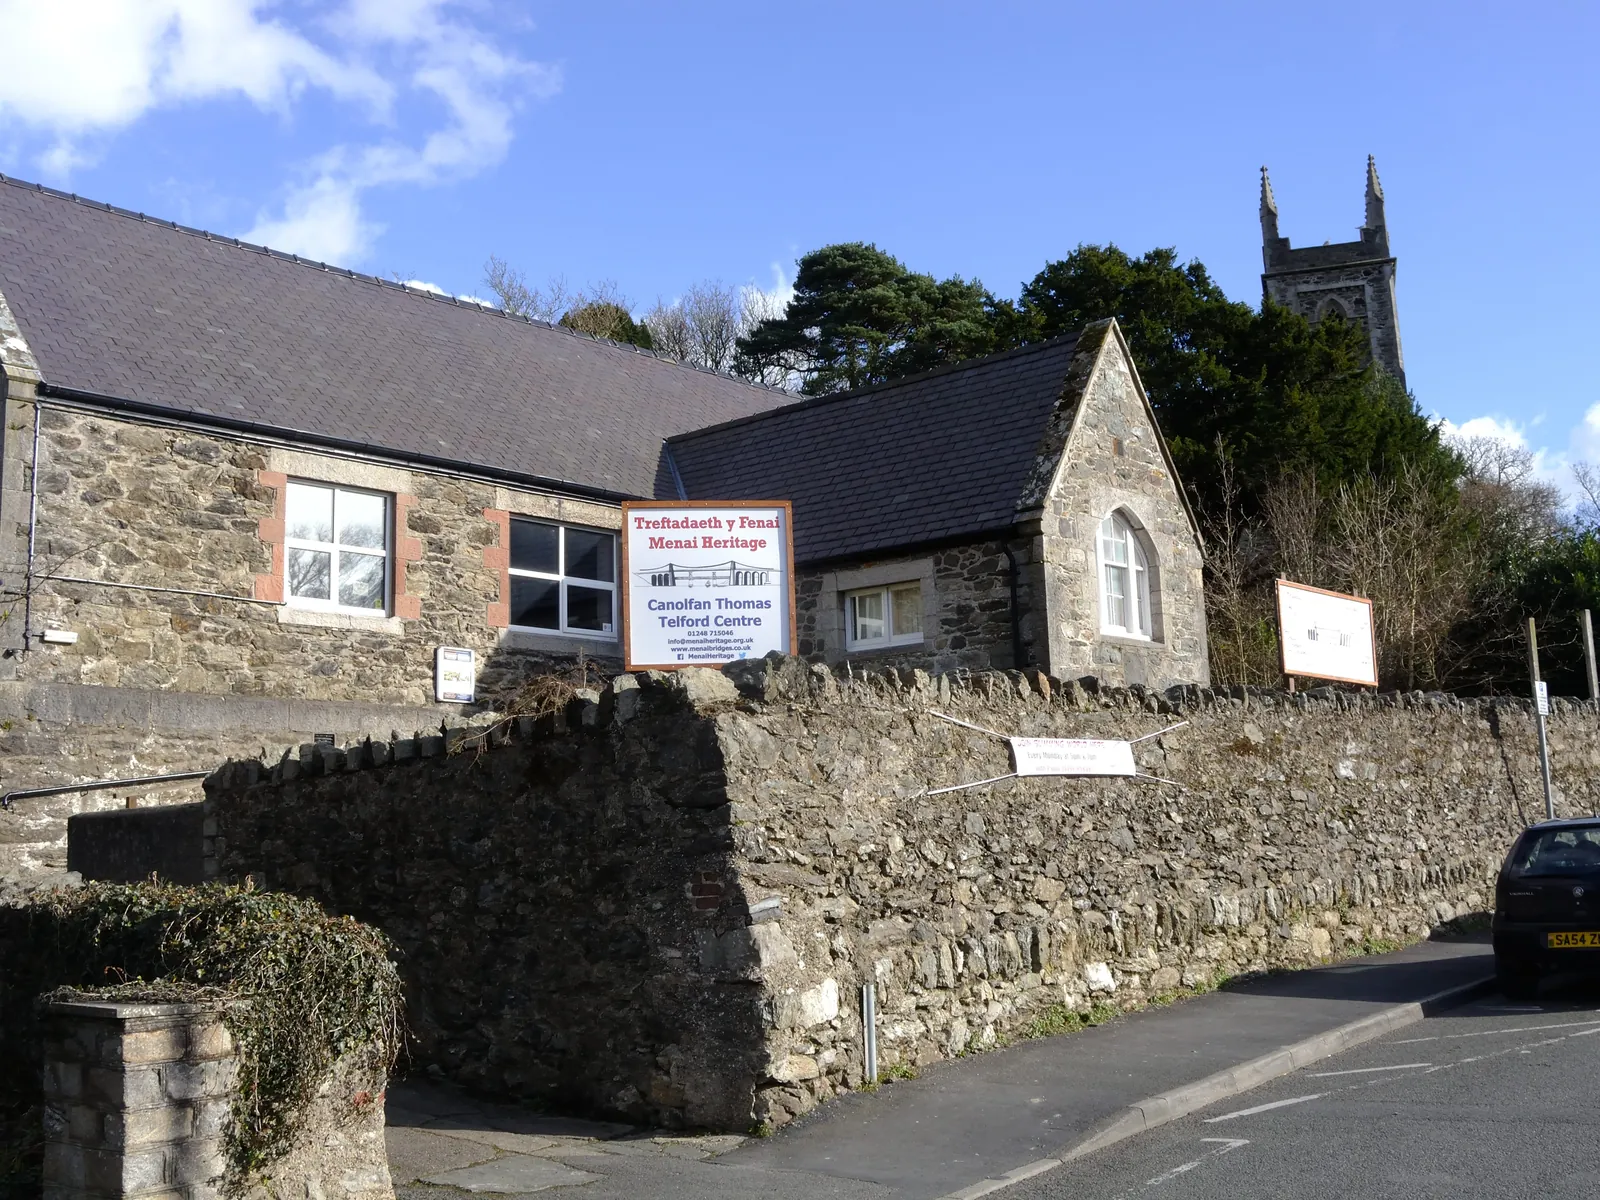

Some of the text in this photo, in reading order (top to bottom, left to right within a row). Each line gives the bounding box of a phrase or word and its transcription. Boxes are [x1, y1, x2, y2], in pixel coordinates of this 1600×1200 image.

[634, 516, 780, 532] Treftadaeth y Fenai
[649, 536, 767, 551] Menai Heritage
[647, 598, 772, 611] Canolfan Thomas
[658, 615, 762, 628] Telford Centre
[668, 637, 754, 645] info@menaiheritage.org.uk
[670, 645, 751, 653] www.menaibridges.co.uk
[1555, 933, 1587, 945] SA54
